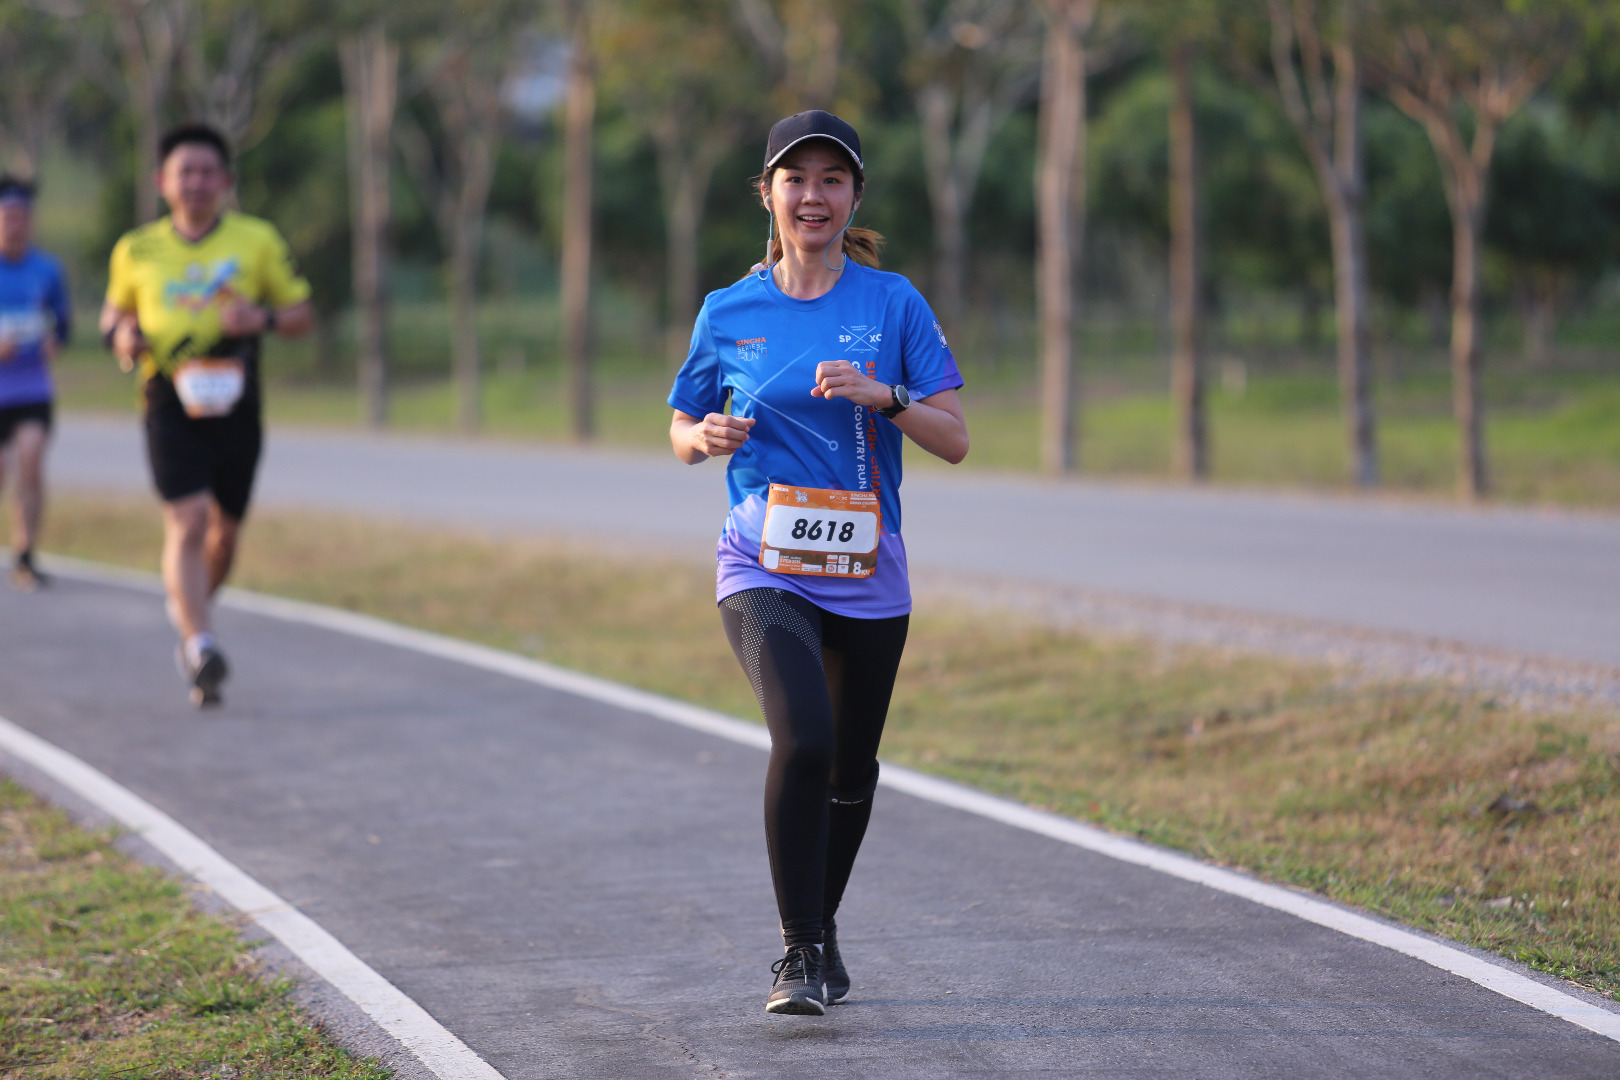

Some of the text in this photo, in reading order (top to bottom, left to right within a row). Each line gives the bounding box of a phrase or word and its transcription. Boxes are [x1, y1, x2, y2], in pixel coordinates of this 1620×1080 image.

[736, 337, 767, 347] SINGHA
[838, 333, 882, 343] SP XC
[737, 343, 761, 353] SERIES
[854, 405, 866, 461] COUNTRY
[857, 464, 868, 490] RUN
[791, 518, 855, 542] 8618
